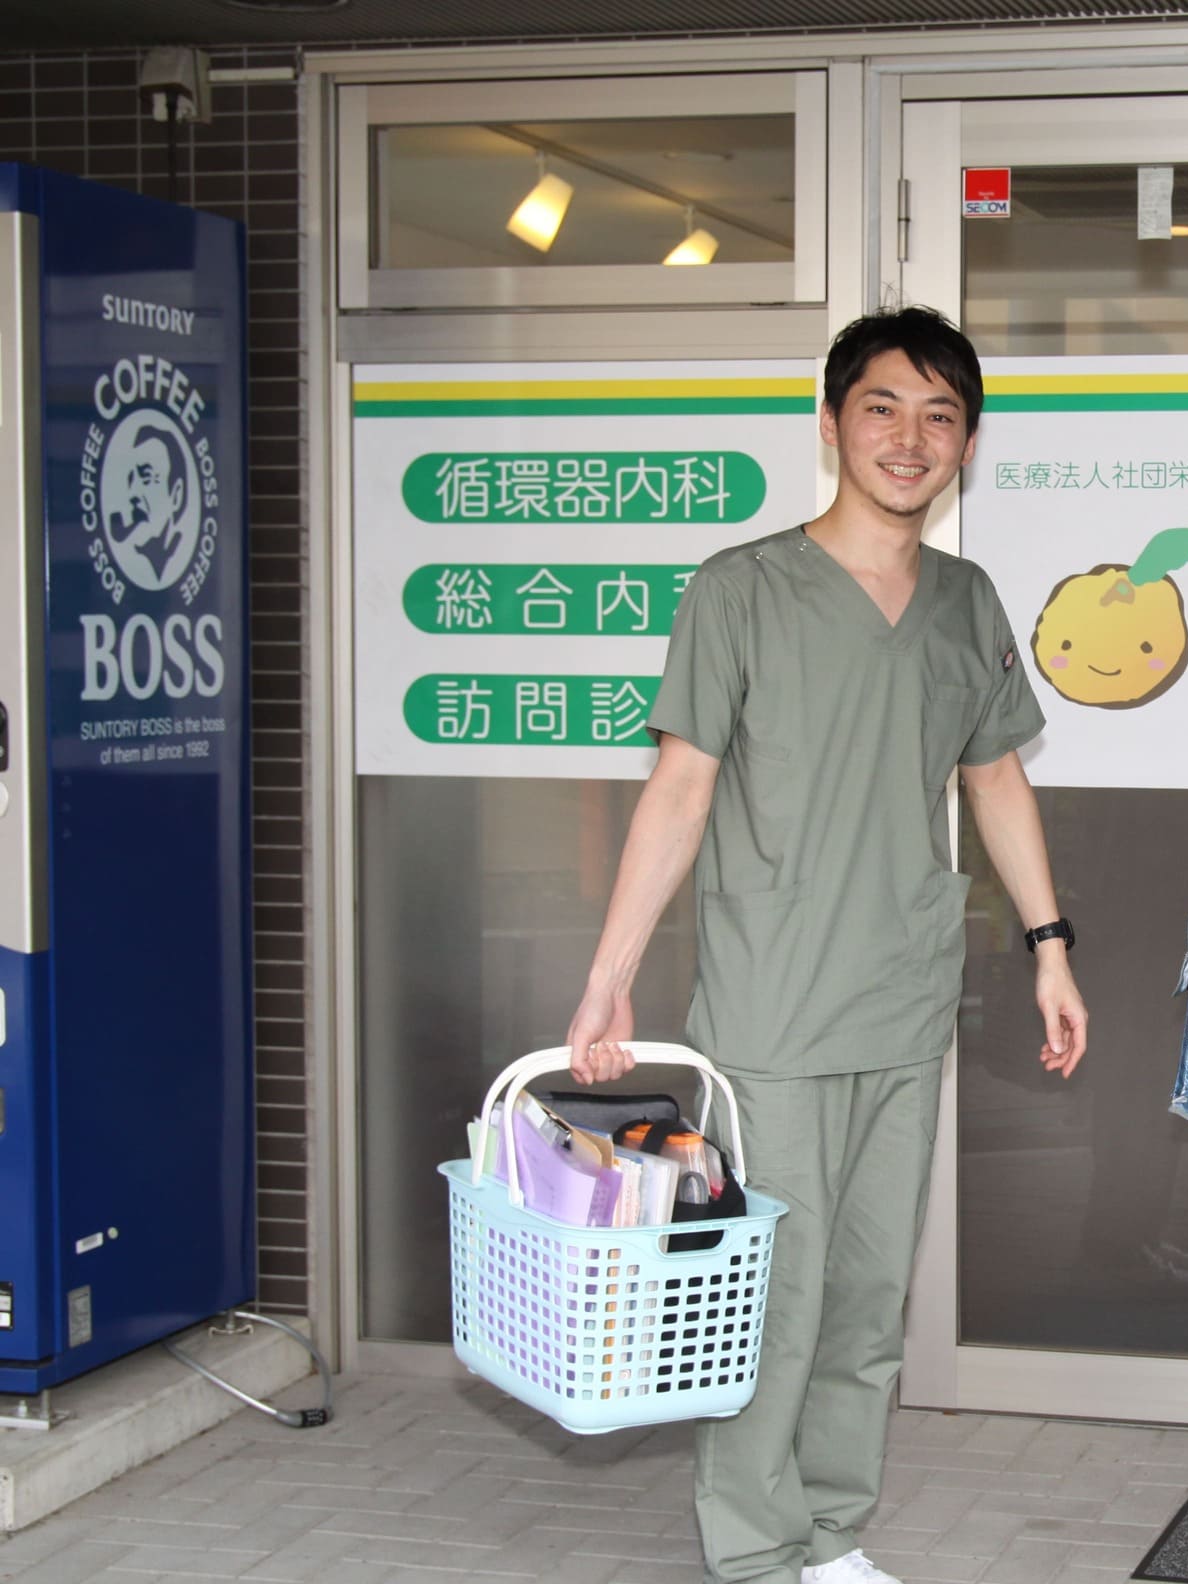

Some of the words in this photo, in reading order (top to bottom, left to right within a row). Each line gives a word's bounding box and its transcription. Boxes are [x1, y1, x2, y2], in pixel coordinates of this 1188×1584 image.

[966, 202, 1007, 213] SECOM
[102, 293, 195, 335] SUNTORY
[94, 354, 206, 434] COFFEE
[80, 423, 105, 532] COFFEE
[195, 437, 219, 508] BOSS
[435, 455, 731, 520] 循環器内科
[88, 538, 125, 605] BOSS
[179, 517, 218, 606] COFFEE
[436, 568, 695, 631] 総合内
[80, 613, 225, 701] BOSS
[80, 720, 138, 740] SUNTORY
[140, 717, 173, 736] BOSS
[174, 719, 183, 733] is
[184, 717, 200, 733] the
[202, 716, 226, 732] boss
[436, 679, 649, 741] 訪問診
[100, 747, 112, 765] of
[113, 747, 140, 764] them
[142, 744, 155, 762] all
[157, 744, 183, 760] since
[186, 740, 209, 757] 1992
